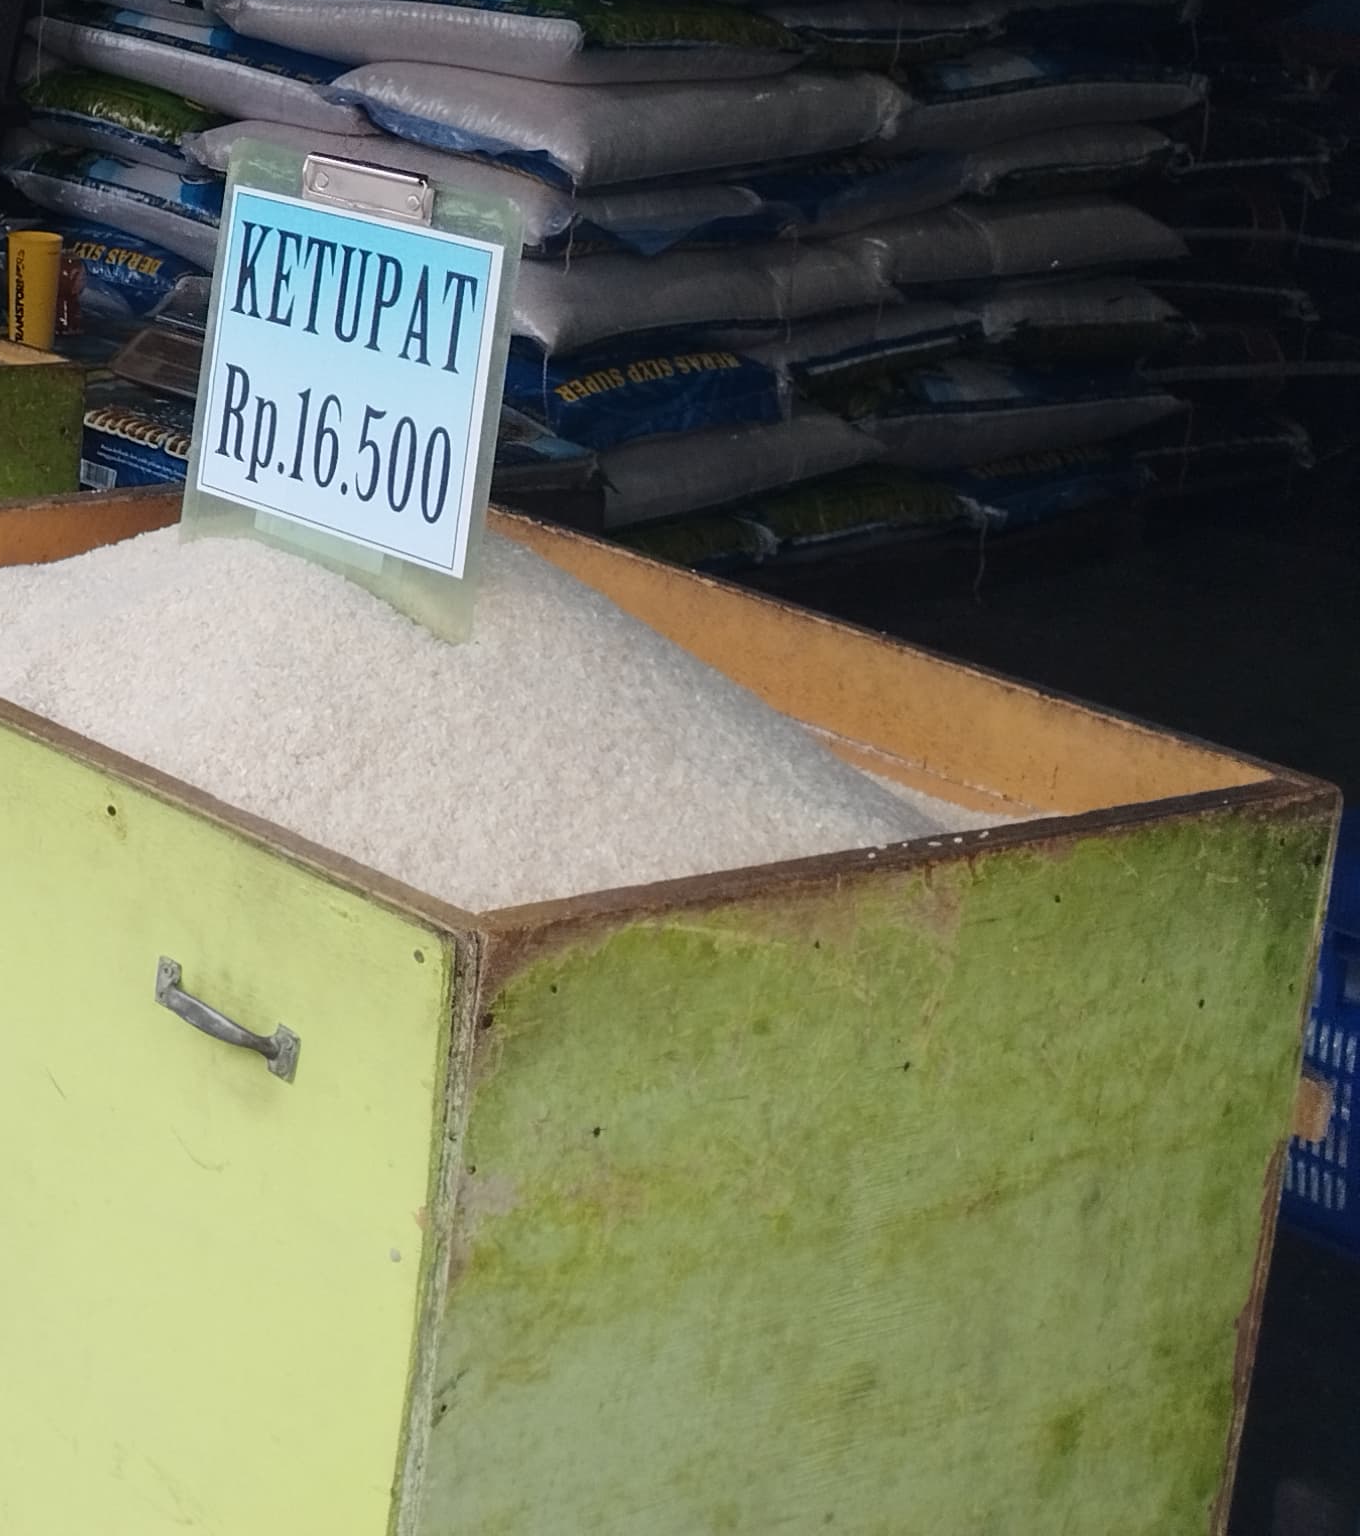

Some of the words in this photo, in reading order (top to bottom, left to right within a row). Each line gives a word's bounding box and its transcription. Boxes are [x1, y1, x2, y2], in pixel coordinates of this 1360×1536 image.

[103, 247, 163, 277] BERAS
[230, 220, 479, 375] KETUPAT
[552, 366, 627, 404] SUPER
[214, 362, 453, 524] Rp.16.500
